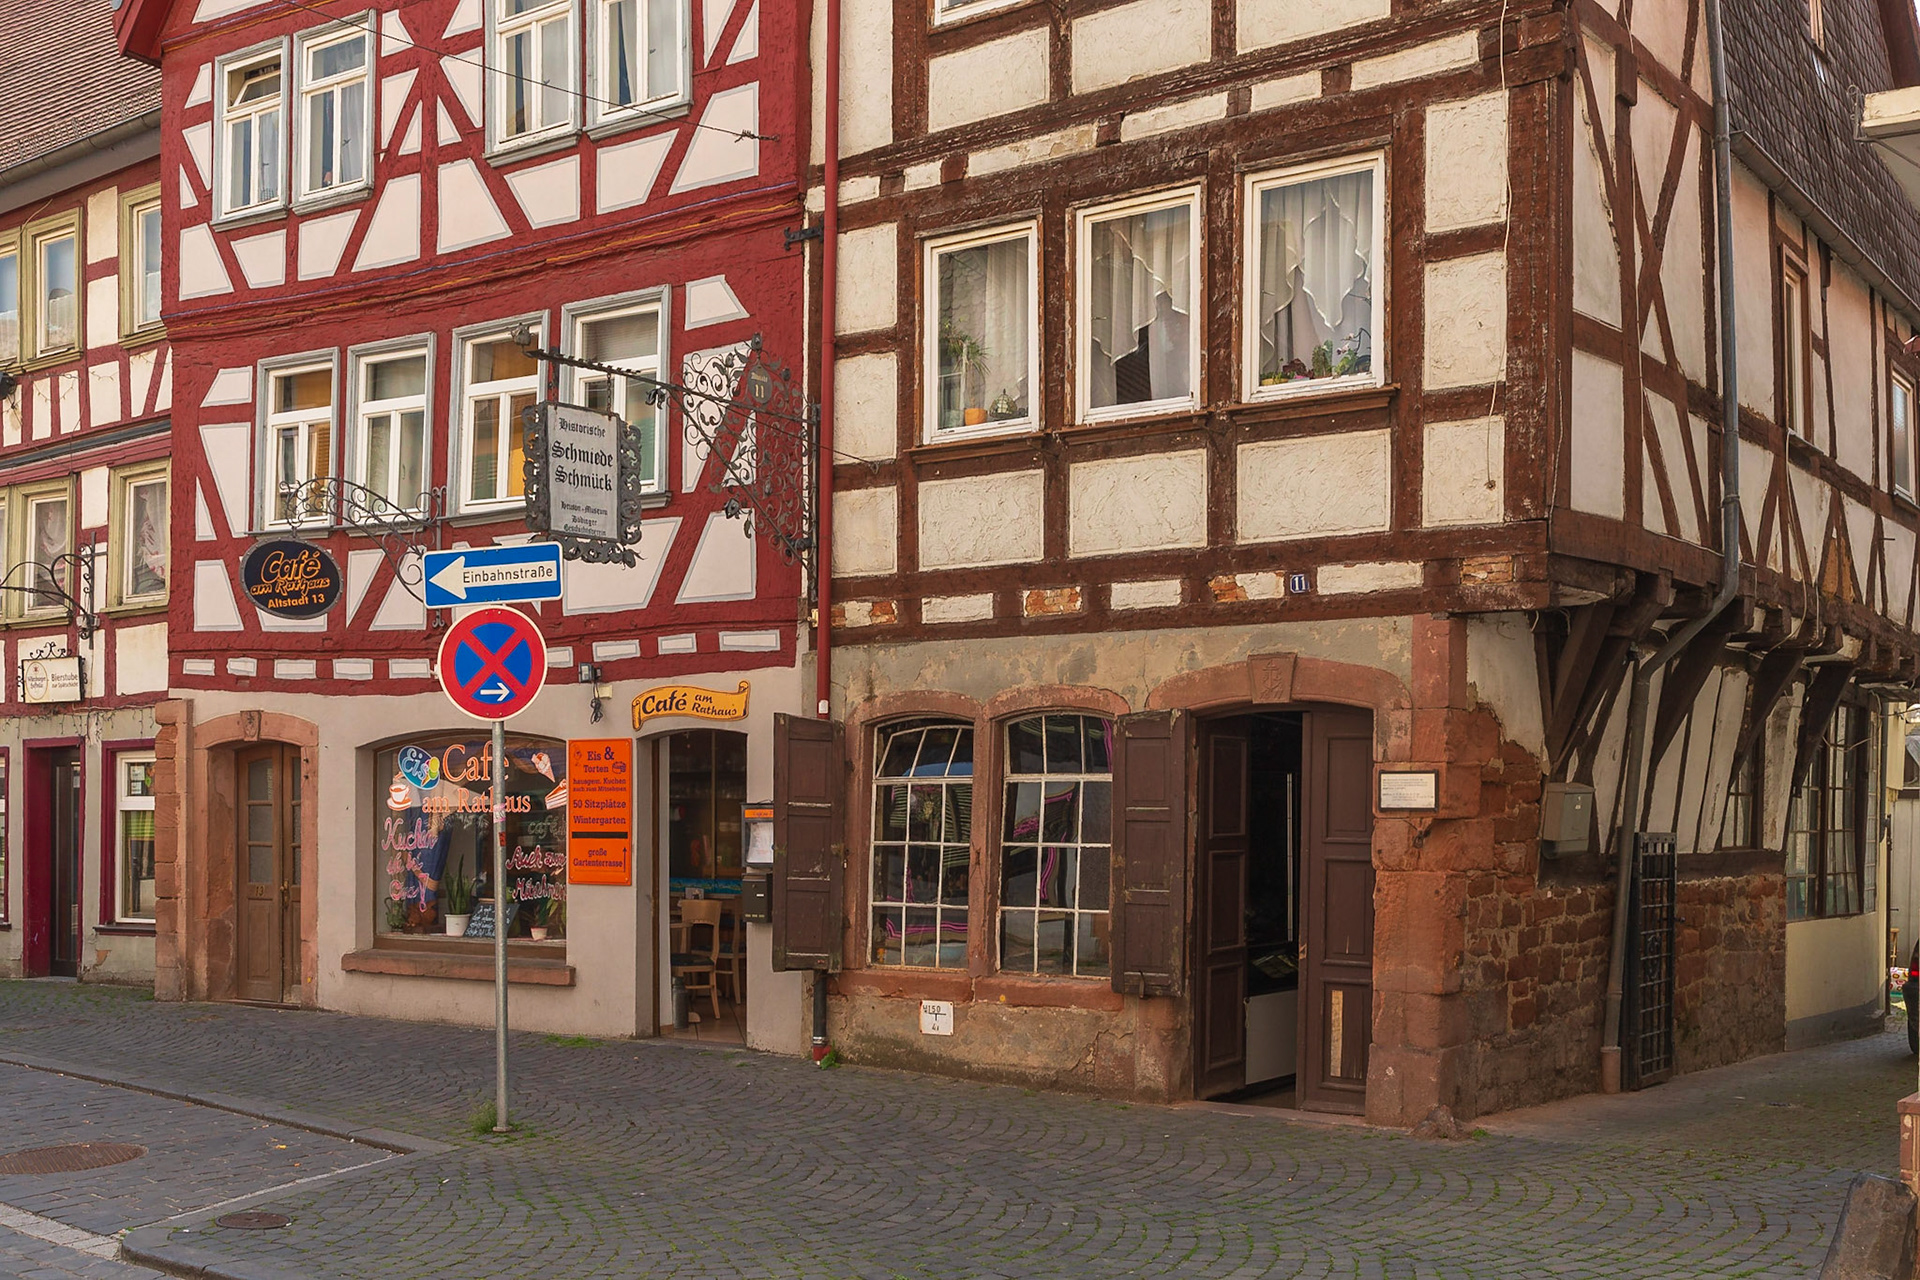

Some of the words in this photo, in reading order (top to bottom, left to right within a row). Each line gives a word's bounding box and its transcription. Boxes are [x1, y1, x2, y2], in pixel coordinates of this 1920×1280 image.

[755, 384, 765, 399] 11
[559, 417, 606, 438] Historische
[552, 440, 614, 468] Schmiede
[555, 464, 613, 491] Schmück
[261, 549, 321, 584] Café
[463, 565, 553, 584] Einbahnstraße
[250, 583, 272, 596] am
[274, 577, 331, 597] Rathaus
[1294, 576, 1306, 591] 11
[267, 596, 309, 609] Altstadt
[312, 593, 325, 604] 13
[51, 673, 78, 681] Bierstube
[642, 690, 687, 715] Café
[694, 694, 713, 704] am
[691, 702, 737, 716] Rathaus
[587, 750, 602, 761] Eis
[604, 745, 615, 761] &
[402, 748, 429, 782] Eis
[583, 764, 609, 773] Torten
[603, 777, 626, 785] Kuchen
[422, 794, 450, 814] am
[573, 799, 583, 809] 50
[584, 798, 626, 810] Sitzplätze
[573, 815, 626, 826] Wintergarten
[382, 816, 438, 851] Kuchen
[506, 844, 543, 870] Auch
[587, 847, 607, 858] große
[572, 857, 623, 868] Gartenterrasse
